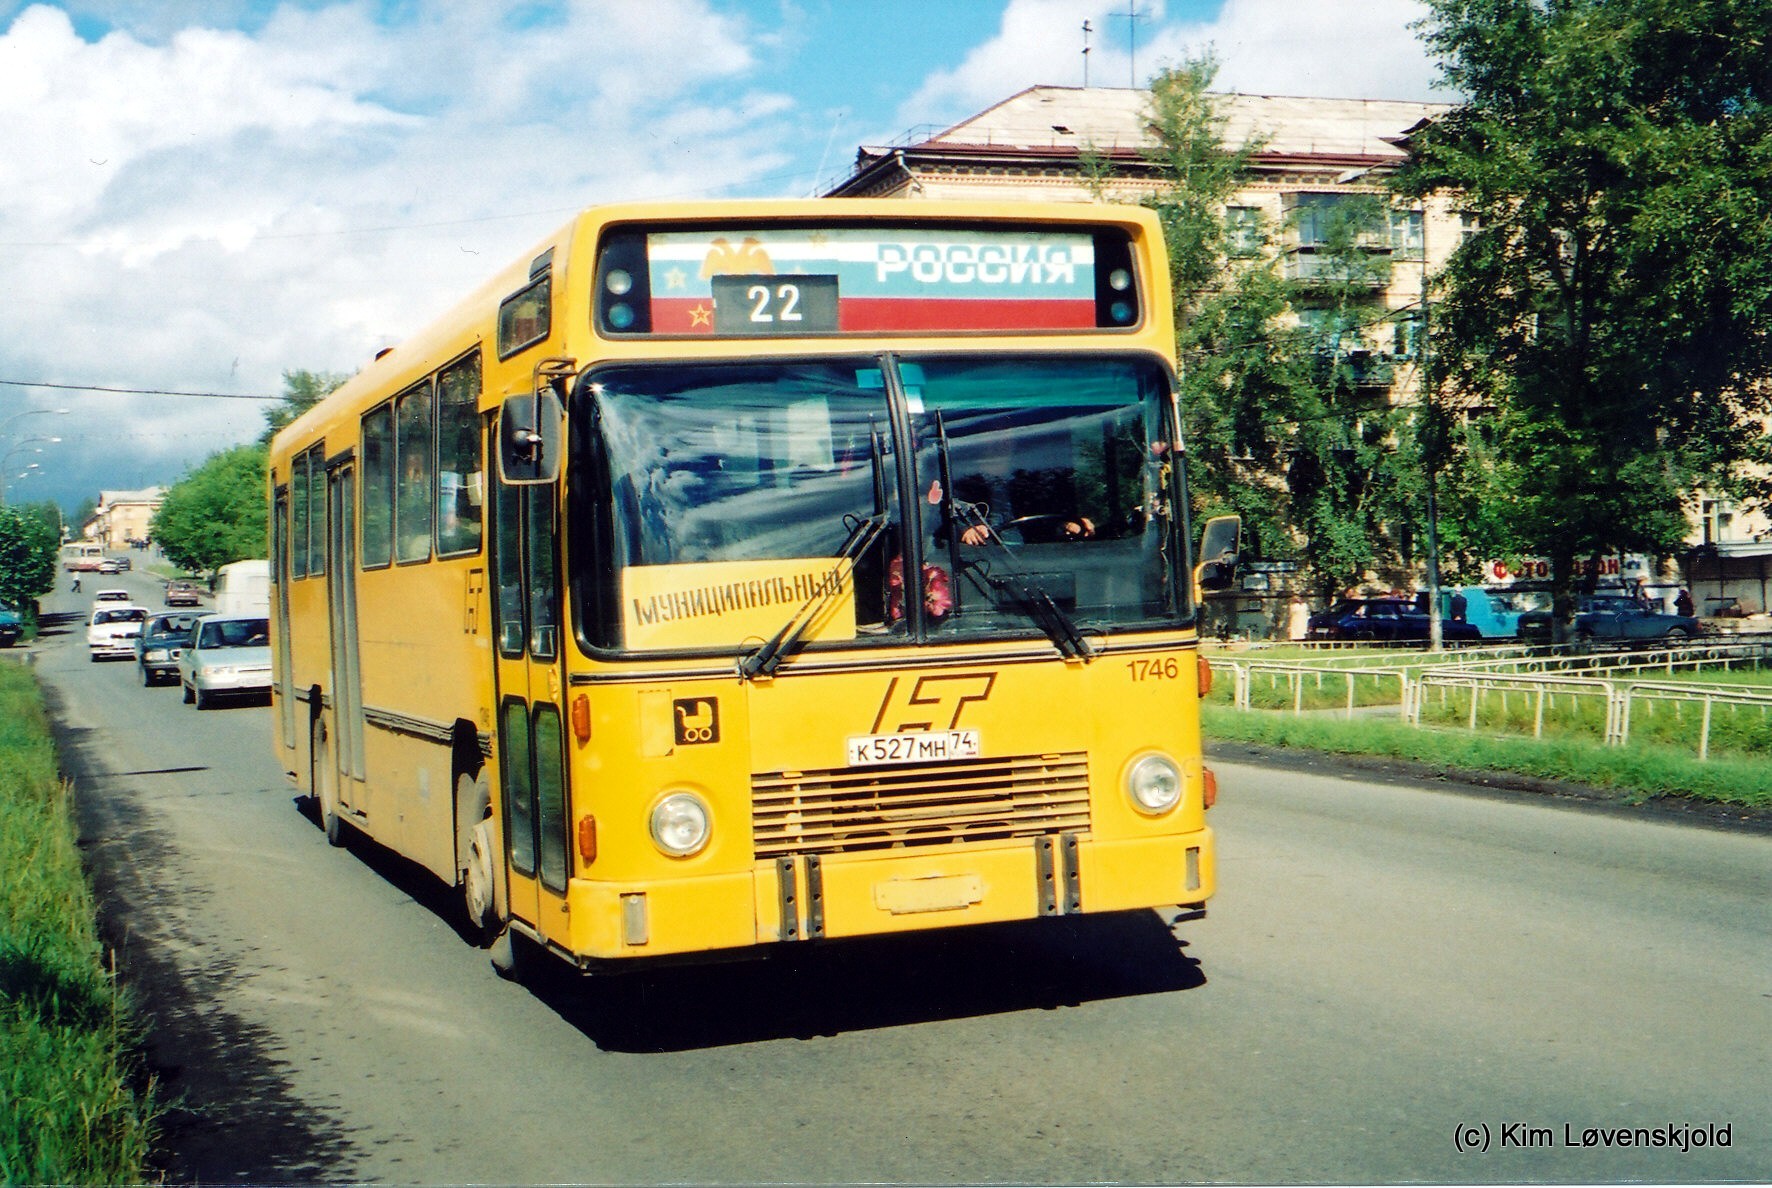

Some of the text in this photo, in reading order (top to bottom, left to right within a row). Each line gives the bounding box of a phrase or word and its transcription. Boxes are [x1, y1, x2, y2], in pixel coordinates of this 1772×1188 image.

[876, 243, 1075, 284] РОССИЯ
[748, 284, 802, 322] 22
[1126, 657, 1178, 682] 1746
